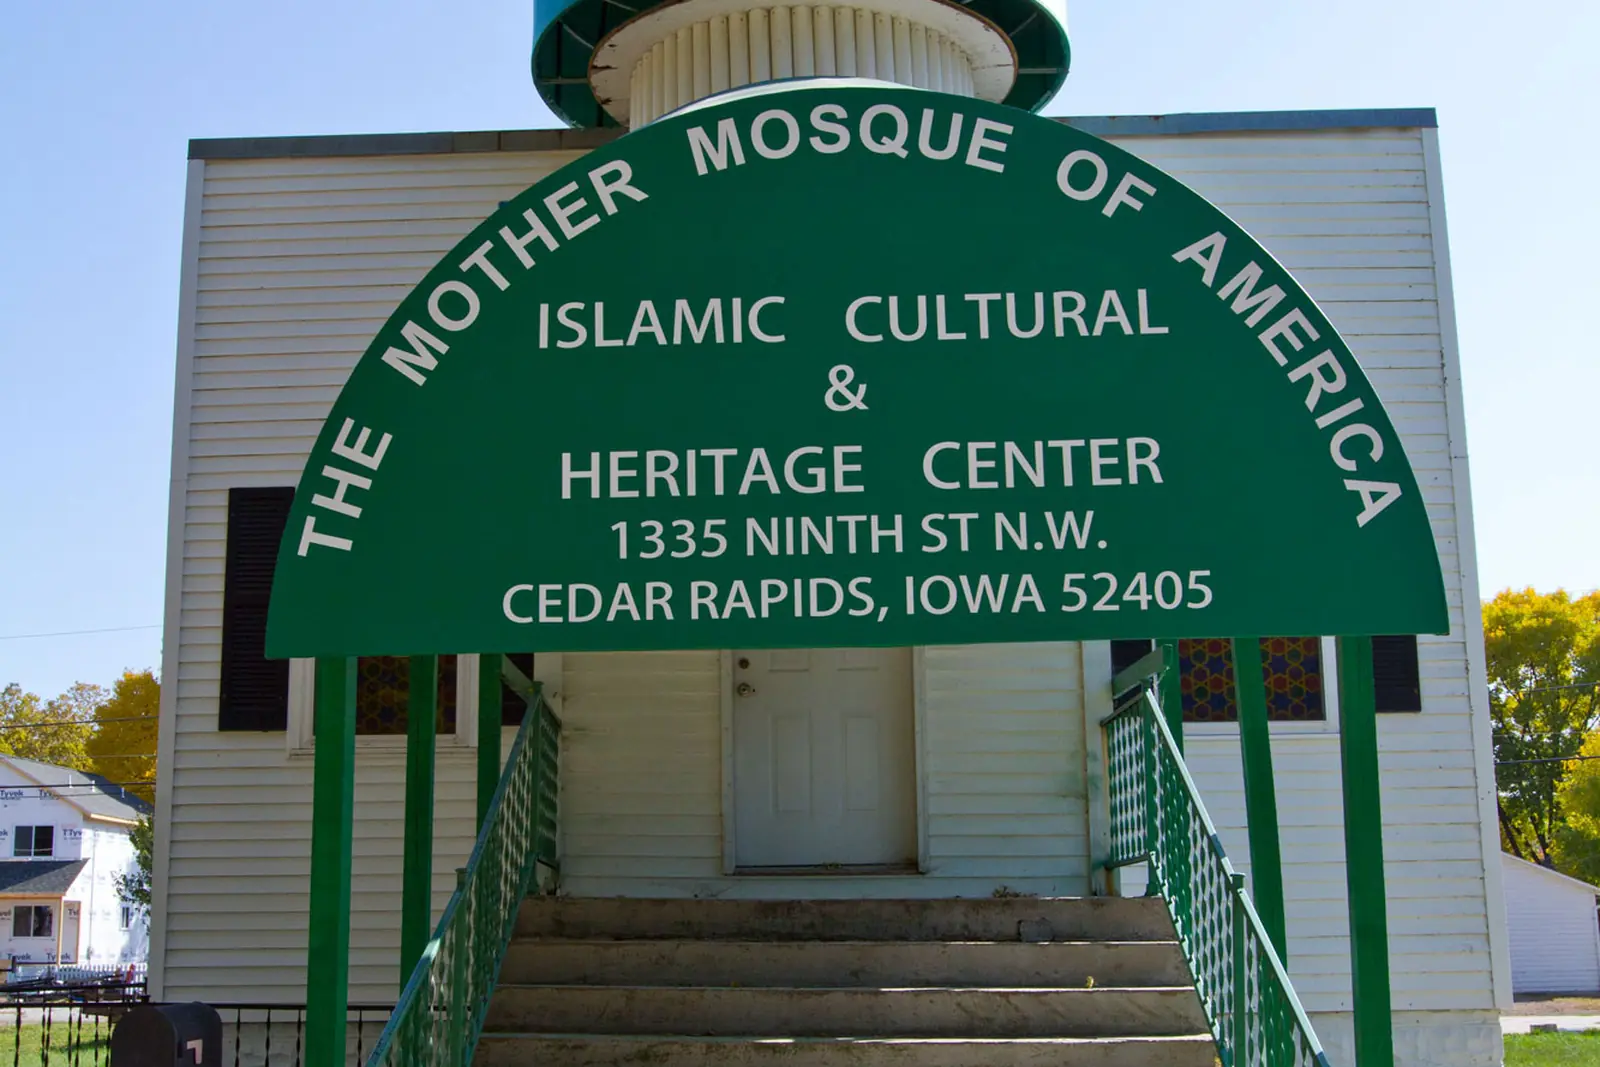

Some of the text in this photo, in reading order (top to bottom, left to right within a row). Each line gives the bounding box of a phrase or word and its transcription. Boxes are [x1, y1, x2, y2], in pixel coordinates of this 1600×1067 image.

[298, 104, 1401, 556] THE MOTHER MOSQUE OF AMERICA
[540, 289, 1168, 348] ISLAMIC CULTURAL
[825, 365, 868, 411] &
[562, 437, 1163, 498] HERITAGE CENTER
[612, 511, 1108, 558] 1335 NINTH ST N.W.
[503, 571, 1212, 623] CEDAR RAPIDS, IOWA 52405
